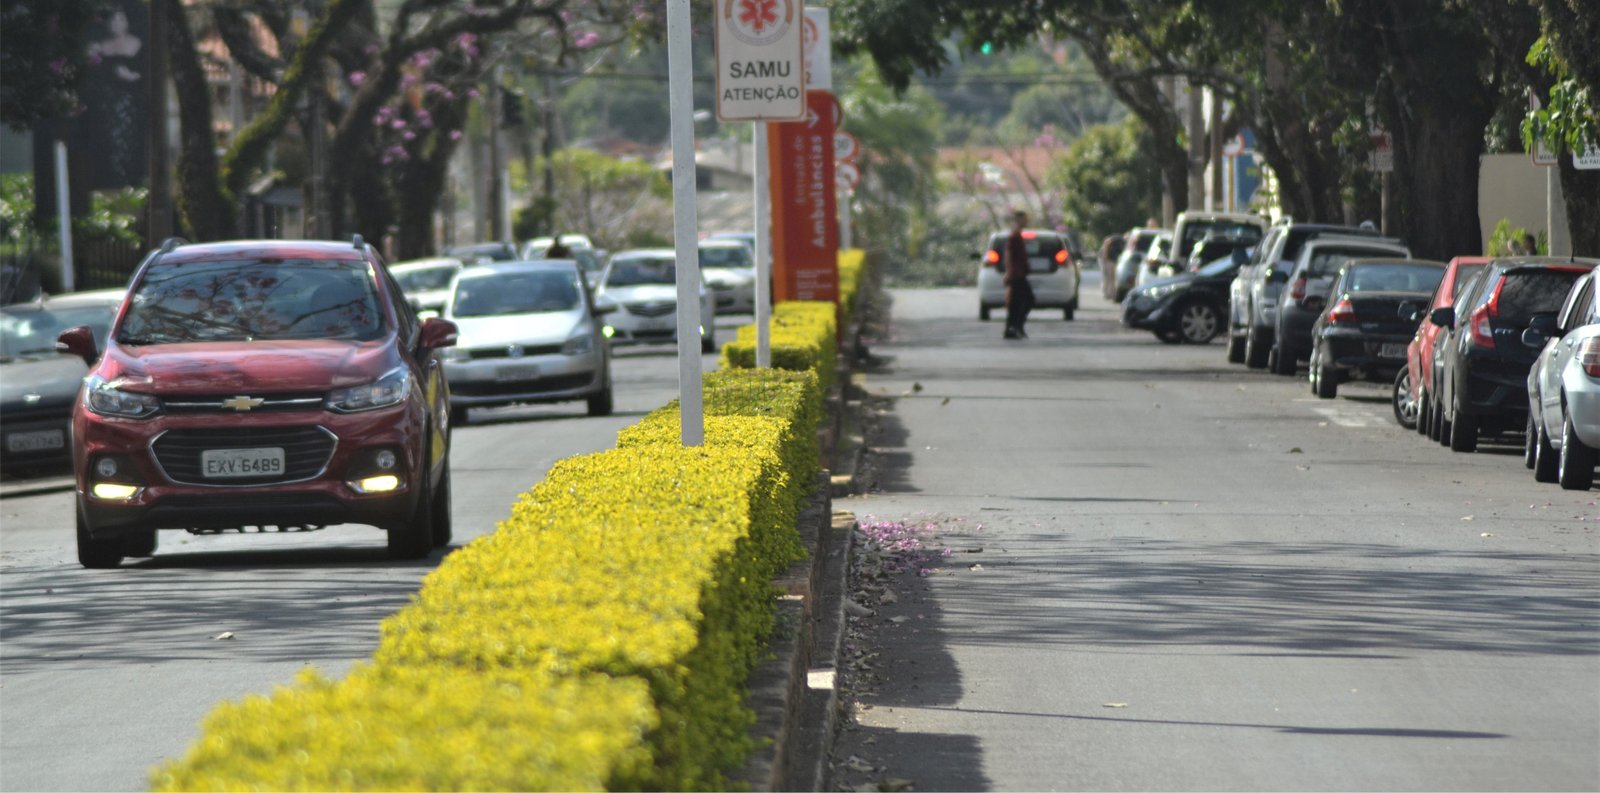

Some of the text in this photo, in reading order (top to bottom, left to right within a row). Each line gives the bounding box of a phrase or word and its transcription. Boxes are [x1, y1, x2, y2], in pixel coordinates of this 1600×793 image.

[730, 60, 791, 79] SAMU
[723, 85, 800, 103] ATENÇÃO
[809, 135, 825, 247] Ambulâncias
